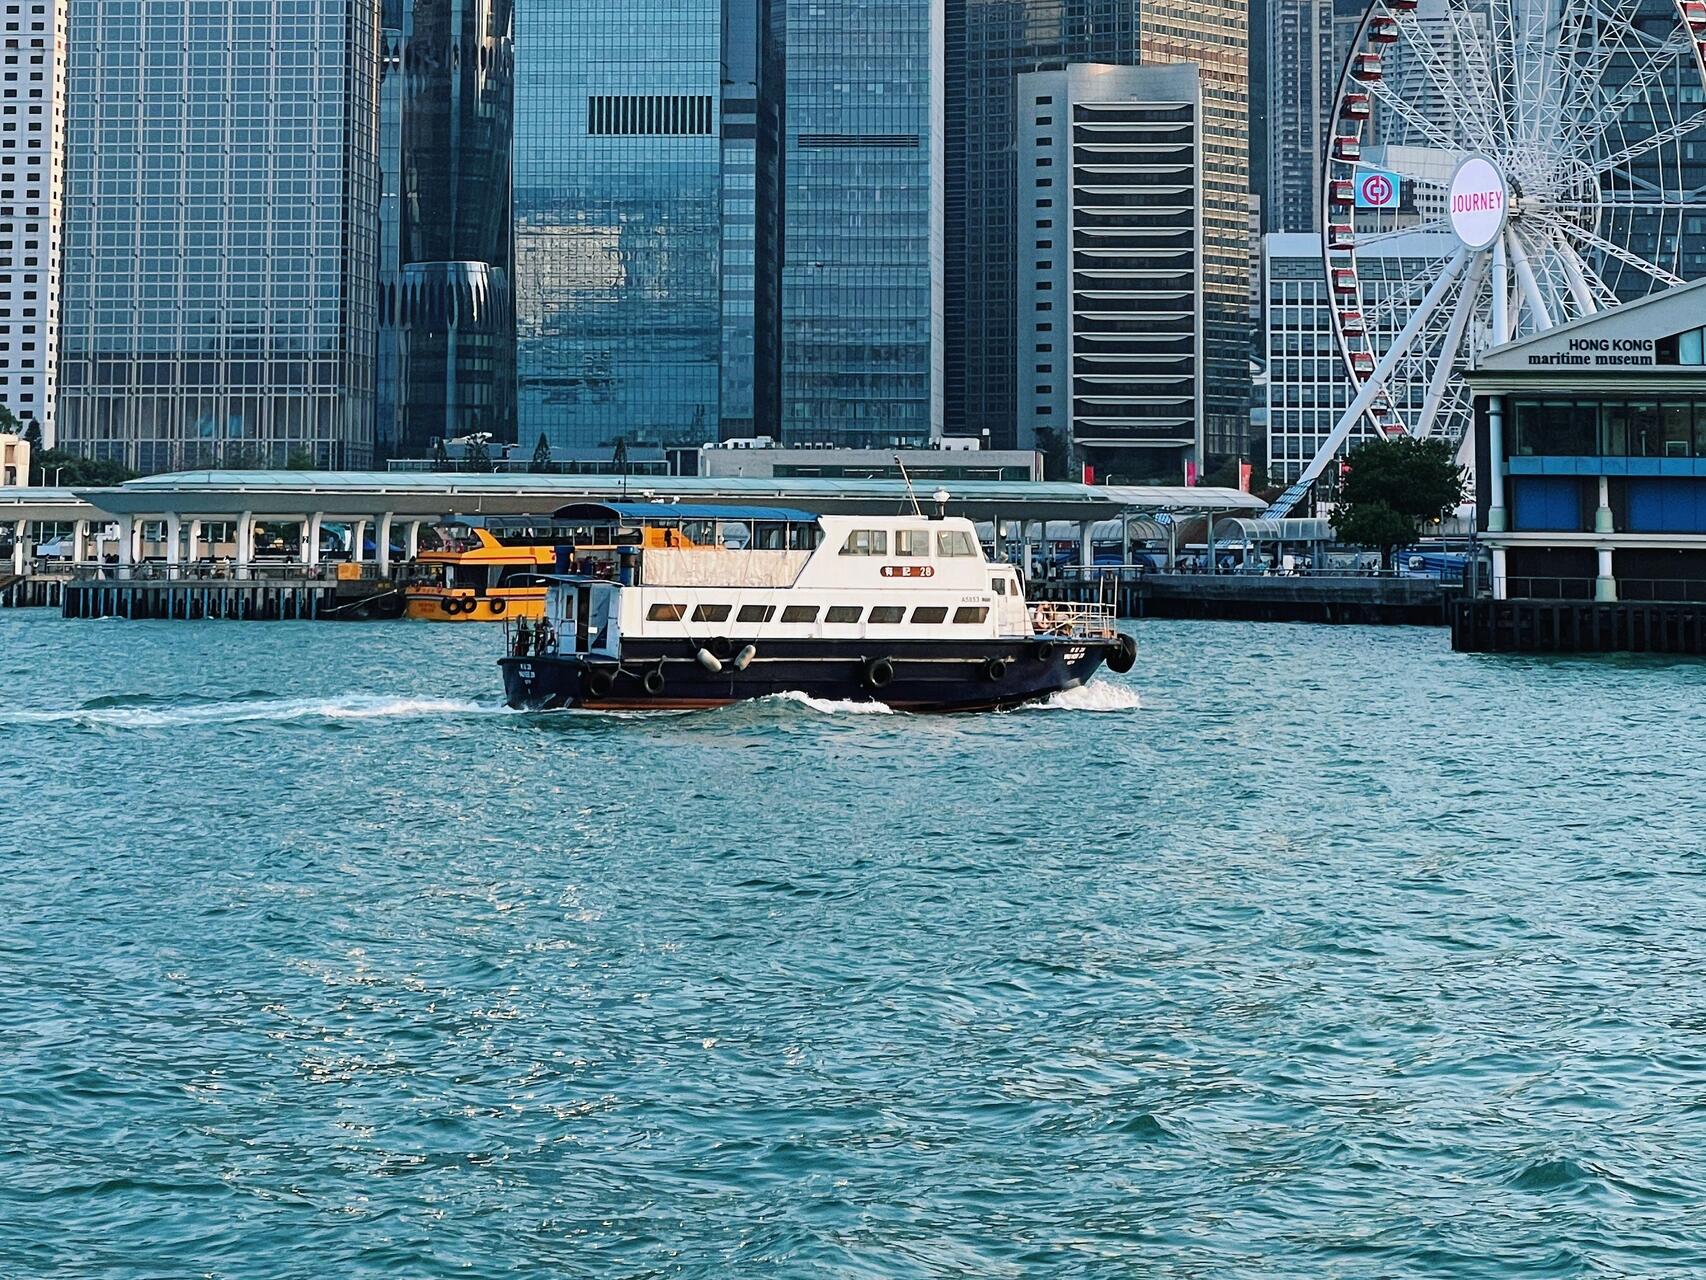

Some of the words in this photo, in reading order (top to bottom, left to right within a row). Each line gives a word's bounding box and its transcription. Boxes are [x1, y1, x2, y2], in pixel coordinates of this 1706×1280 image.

[1452, 190, 1503, 213] JOURNEY
[1569, 338, 1609, 351] HONG
[1612, 338, 1653, 351] KONG
[1528, 352, 1591, 365] maritime
[1595, 355, 1653, 365] museum
[920, 567, 932, 577] 28
